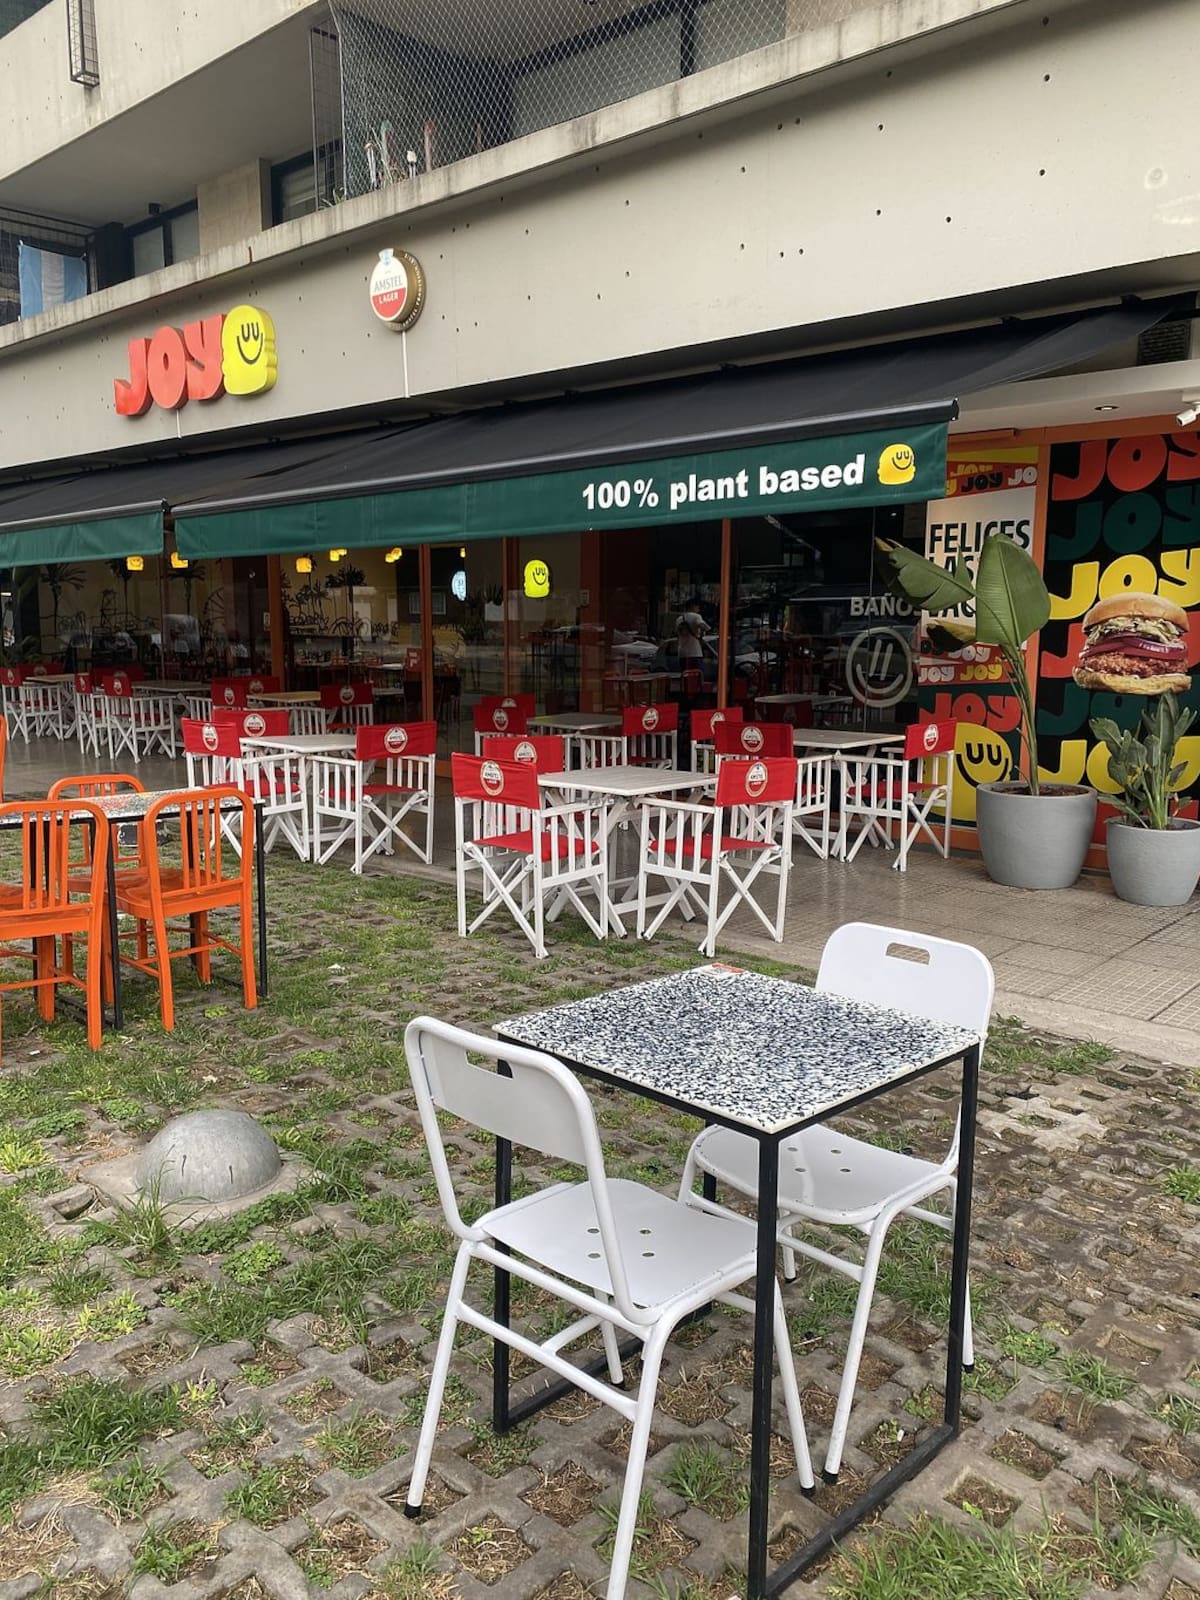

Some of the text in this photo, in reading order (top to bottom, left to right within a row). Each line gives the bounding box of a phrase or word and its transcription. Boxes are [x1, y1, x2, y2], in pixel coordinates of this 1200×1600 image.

[374, 275, 404, 292] AMSTEL
[378, 291, 399, 304] LAGER
[114, 313, 226, 417] JOY
[582, 453, 866, 510] 100% plant based
[961, 472, 1003, 492] JOY
[849, 592, 921, 617] BAÑO
[918, 664, 1003, 683] JOY JOY
[919, 692, 1022, 732] JOY
